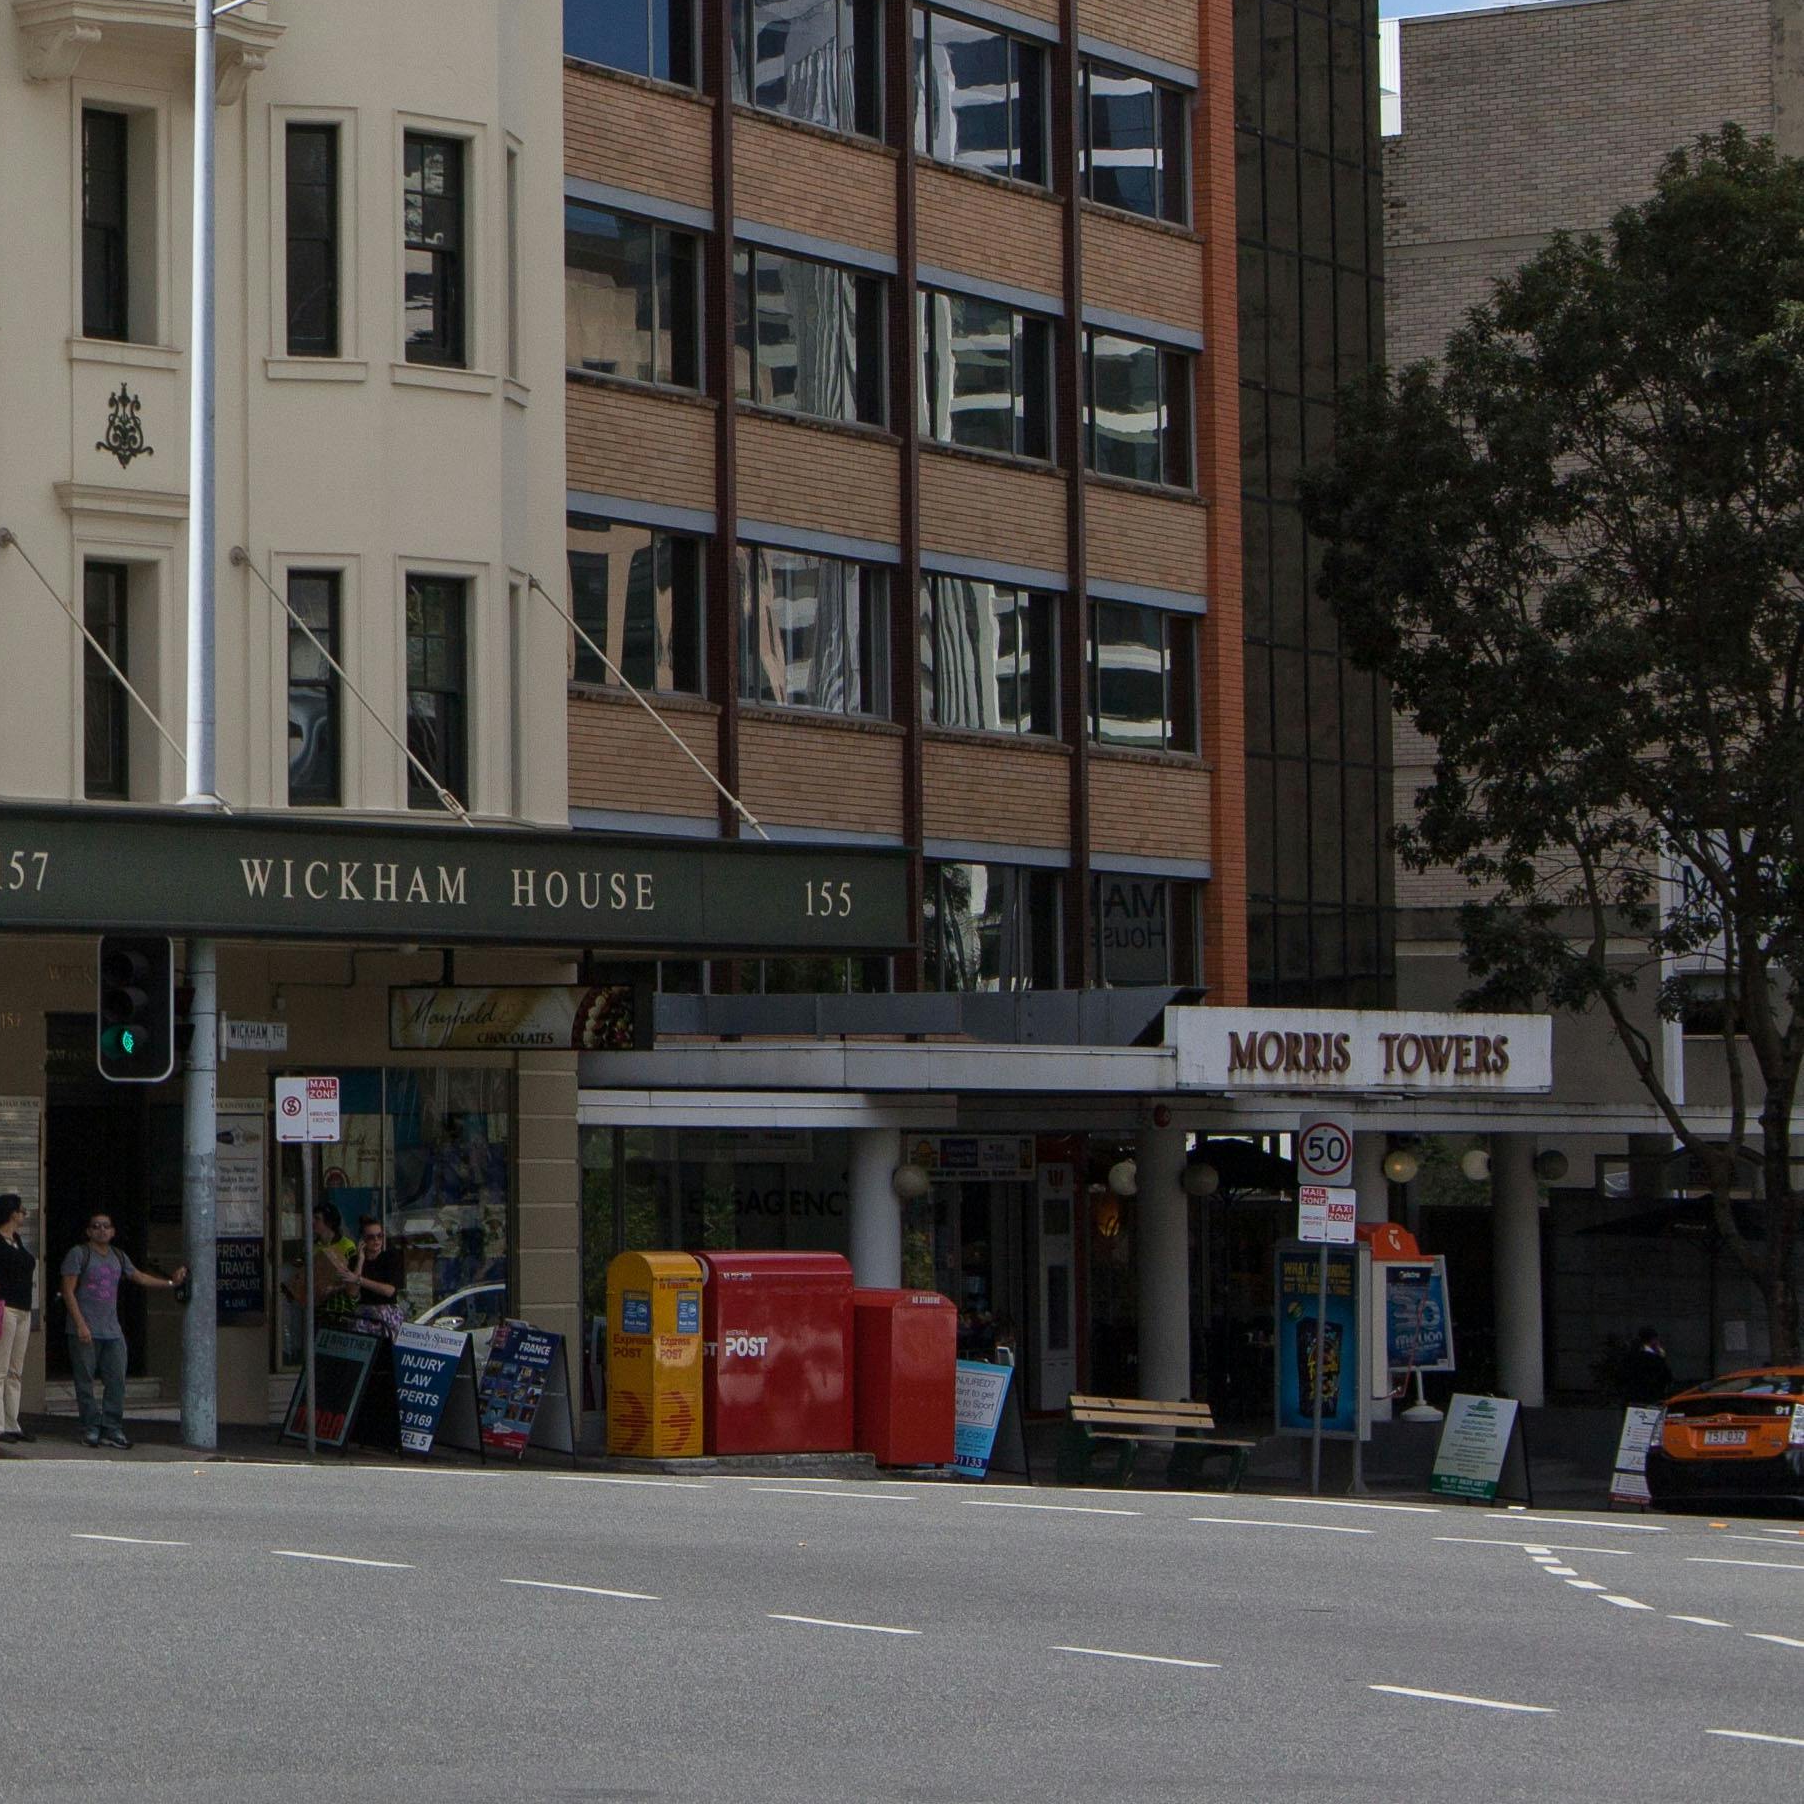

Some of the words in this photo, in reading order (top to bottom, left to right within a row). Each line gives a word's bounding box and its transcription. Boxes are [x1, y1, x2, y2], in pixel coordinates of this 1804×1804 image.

[239, 858, 468, 905] WICKHAM
[511, 868, 656, 911] HOUSE
[804, 881, 854, 917] 155
[404, 991, 497, 1048] Mayfield
[231, 1025, 268, 1039] WICKHAM
[477, 1032, 554, 1045] CHOCOLATES
[1228, 1031, 1351, 1073] MORRIS
[1378, 1033, 1509, 1074] TOWERS
[309, 1079, 336, 1089] MAIL
[309, 1089, 336, 1099] ZONE
[1308, 1136, 1345, 1163] 50
[1302, 1188, 1325, 1197] MAIL
[1301, 1197, 1326, 1205] ZONE
[1330, 1204, 1353, 1213] TAXI
[1329, 1213, 1353, 1222] ZONE
[216, 1244, 260, 1258] FRENCH
[220, 1261, 256, 1275] TRAVEL
[216, 1278, 260, 1291] SPECIALIST
[614, 1334, 652, 1347] Express
[660, 1336, 691, 1347] Express
[725, 1337, 768, 1356] POST
[519, 1341, 552, 1356] FRANCE
[614, 1348, 642, 1358] POST
[660, 1349, 682, 1359] POST
[401, 1354, 446, 1374] INJURY
[404, 1373, 432, 1388] LAW
[957, 1377, 996, 1389] NJURED?
[971, 1389, 979, 1397] to
[982, 1390, 995, 1399] get
[972, 1400, 995, 1411] Sport
[1775, 1405, 1790, 1415] 91
[405, 1412, 432, 1427] 9169
[419, 1435, 427, 1446] 5
